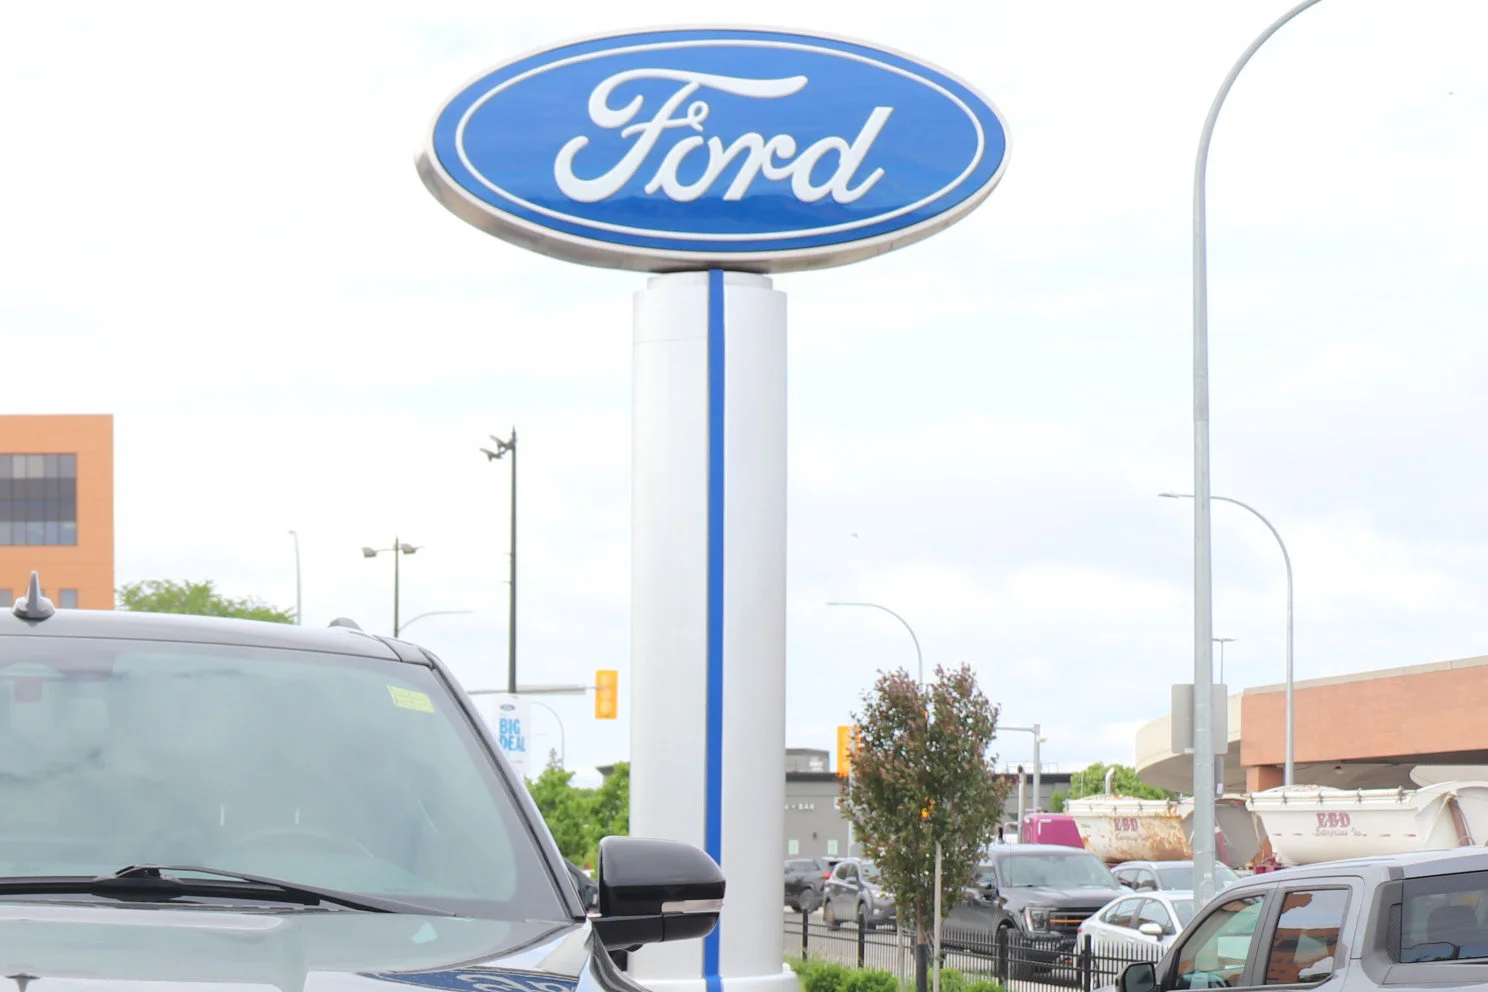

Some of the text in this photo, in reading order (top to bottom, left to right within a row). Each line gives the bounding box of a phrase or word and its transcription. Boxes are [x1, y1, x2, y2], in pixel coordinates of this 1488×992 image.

[553, 68, 894, 204] Ford
[500, 718, 521, 734] BIG
[499, 734, 526, 752] DEAL
